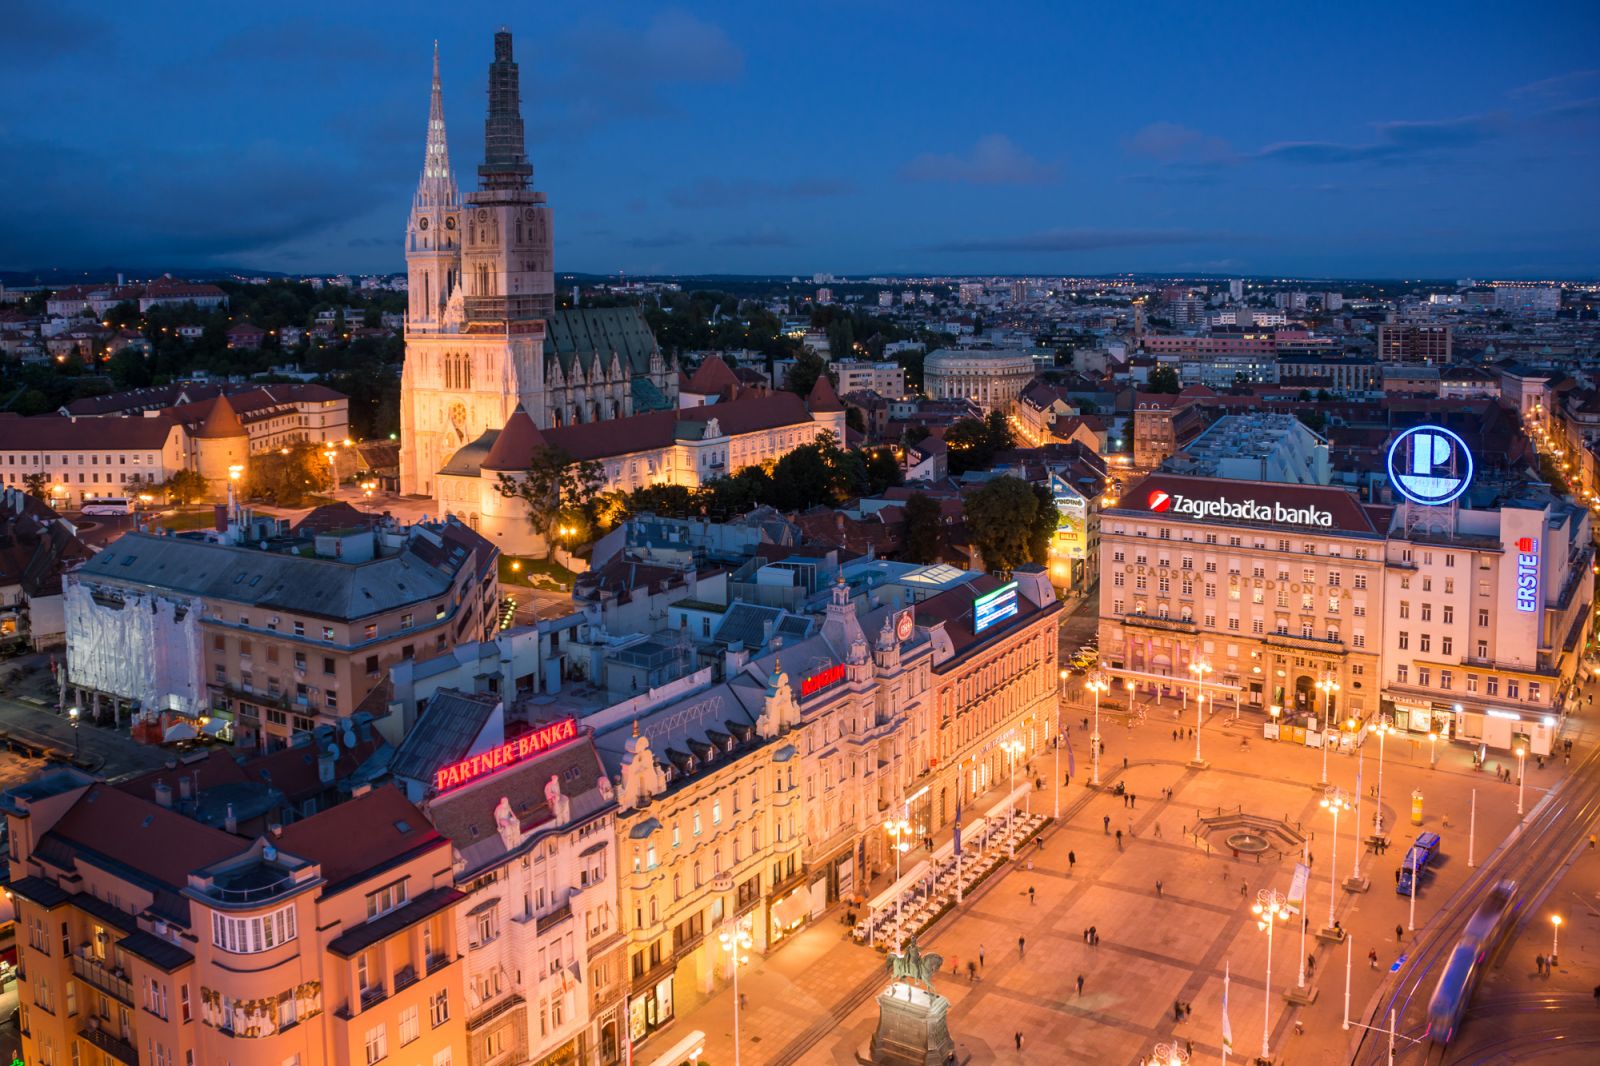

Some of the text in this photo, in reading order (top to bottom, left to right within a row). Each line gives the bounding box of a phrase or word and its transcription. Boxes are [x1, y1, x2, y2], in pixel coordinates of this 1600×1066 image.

[1173, 495, 1332, 527] Zagrebačka banka
[1125, 564, 1204, 583] GRADSKA
[1517, 554, 1538, 612] ERSTE
[437, 720, 575, 790] PARTNER BANKA
